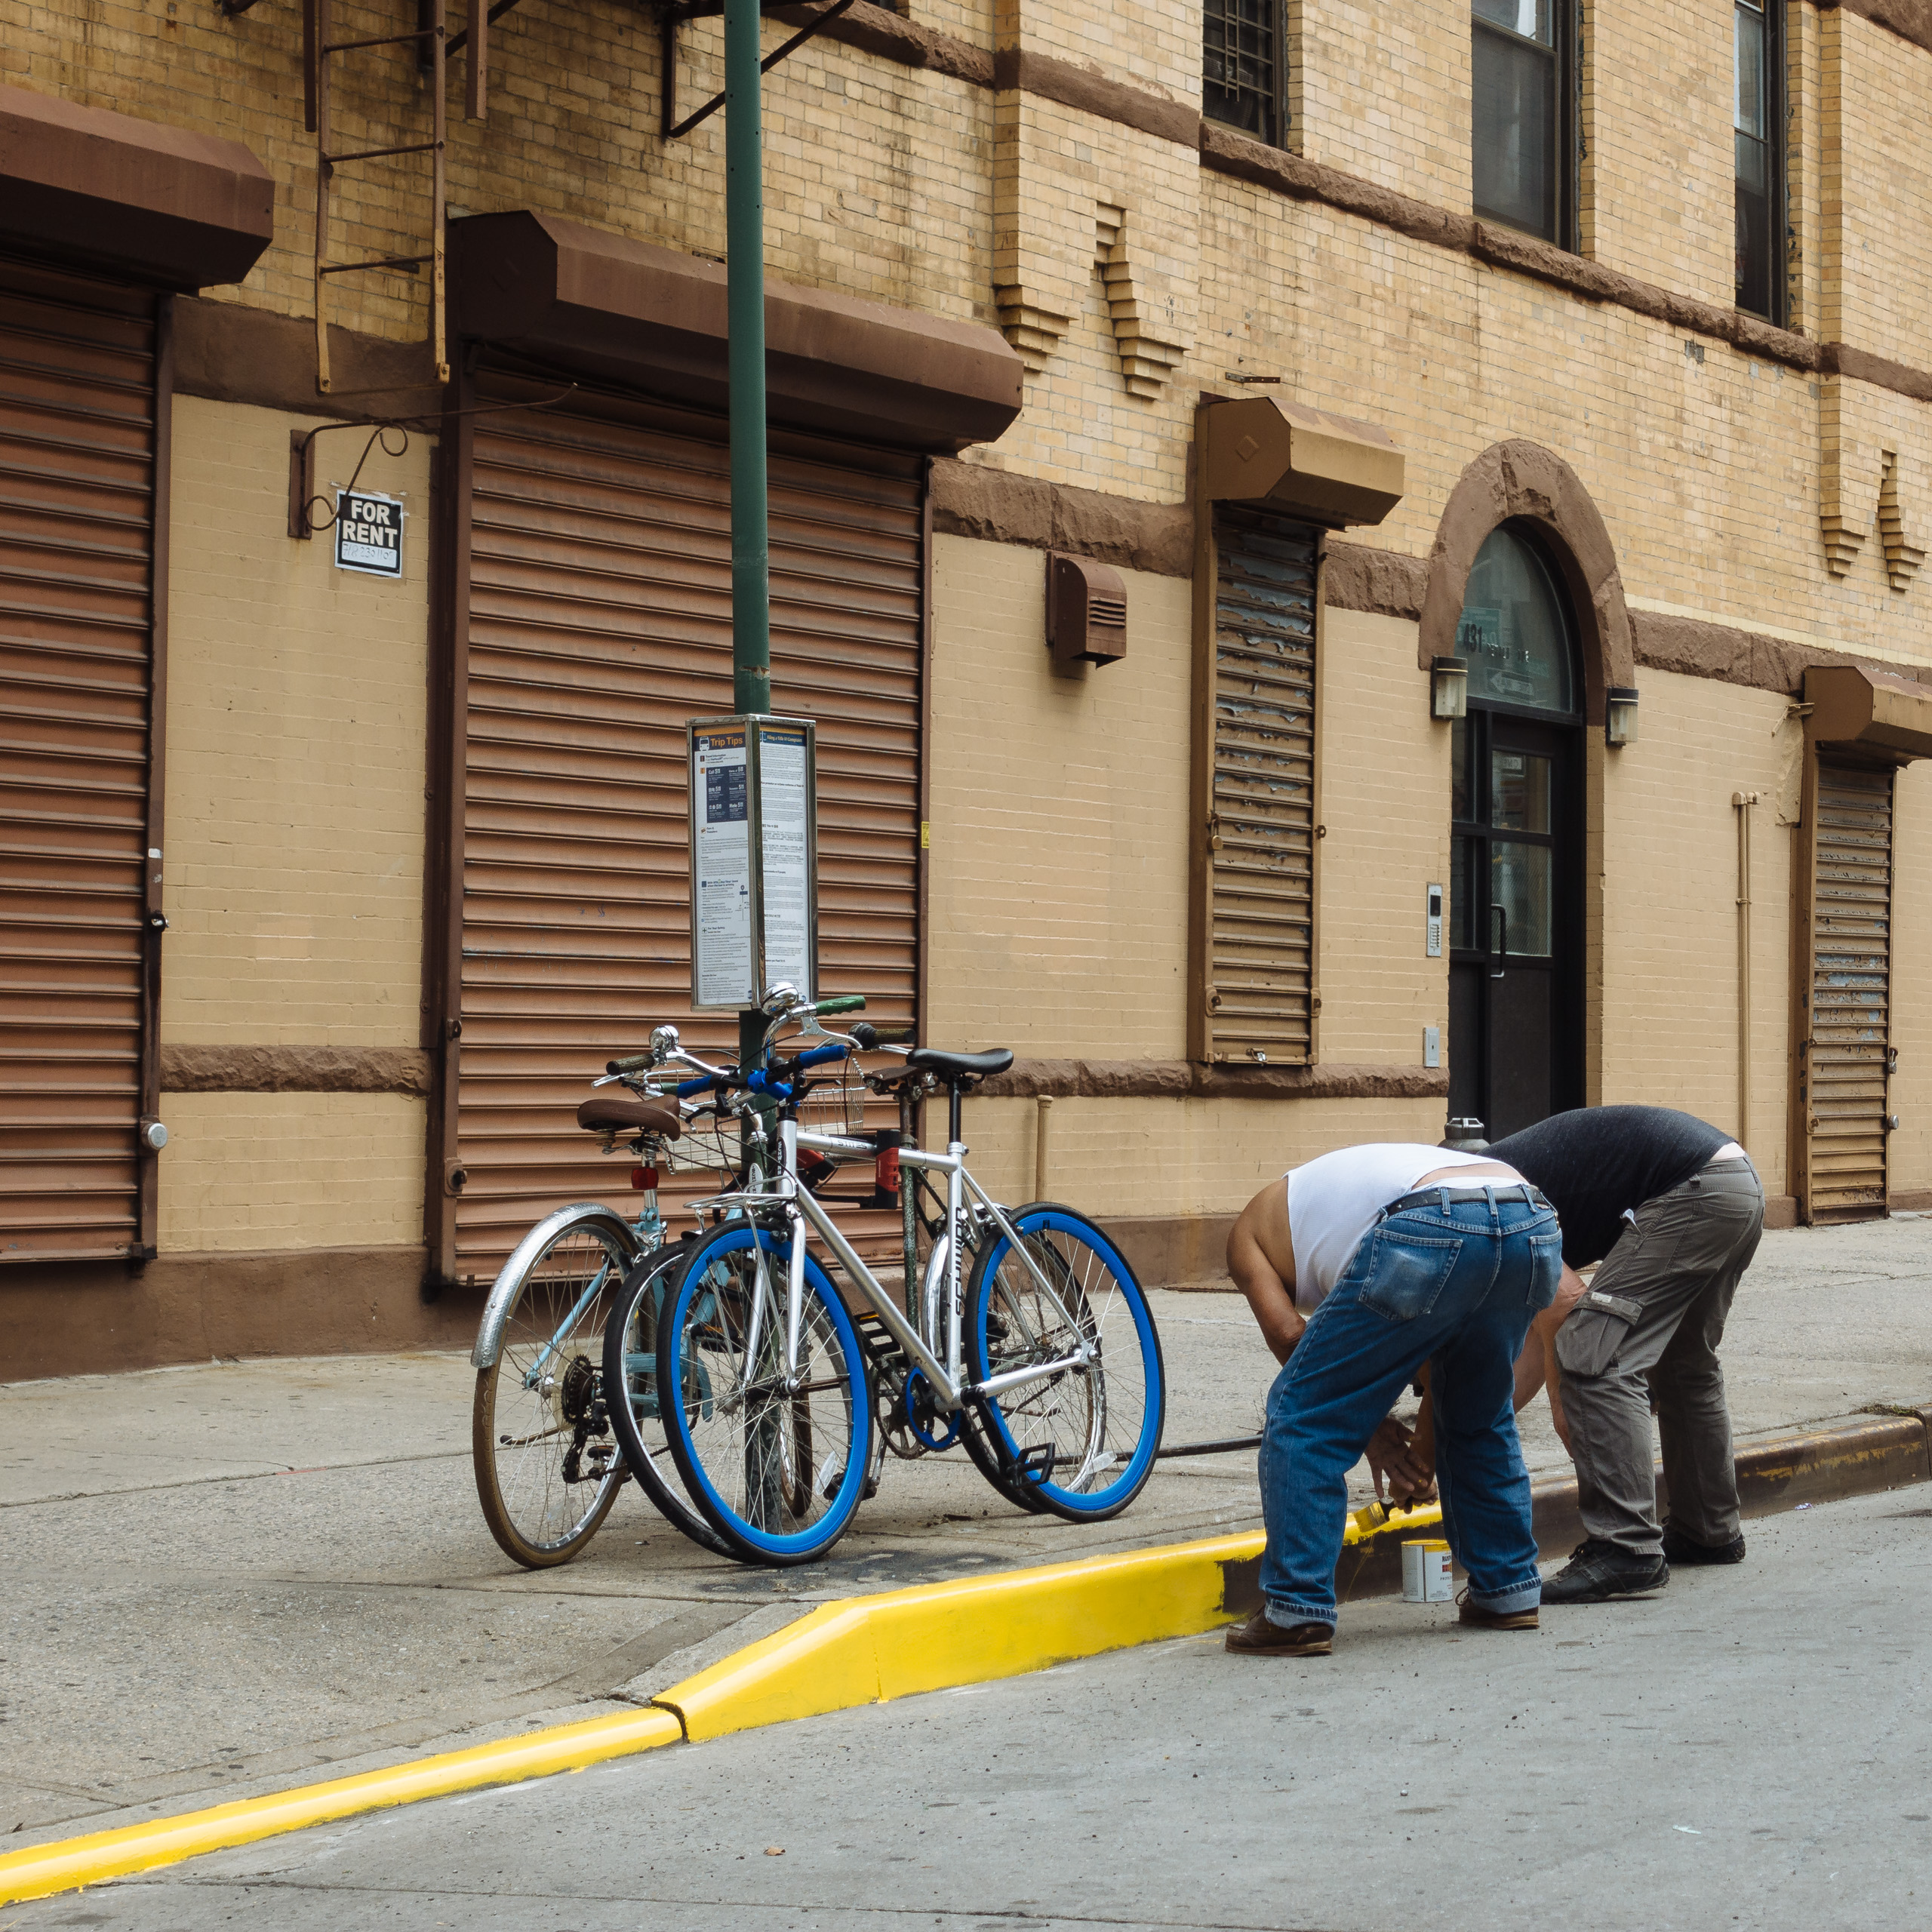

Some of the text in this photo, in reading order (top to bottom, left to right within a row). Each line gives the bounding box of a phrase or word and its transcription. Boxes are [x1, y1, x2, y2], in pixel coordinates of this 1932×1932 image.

[351, 500, 391, 525] FOR
[343, 520, 398, 548] RENT
[710, 736, 743, 748] Trip Tips
[838, 1140, 867, 1149] STITES
